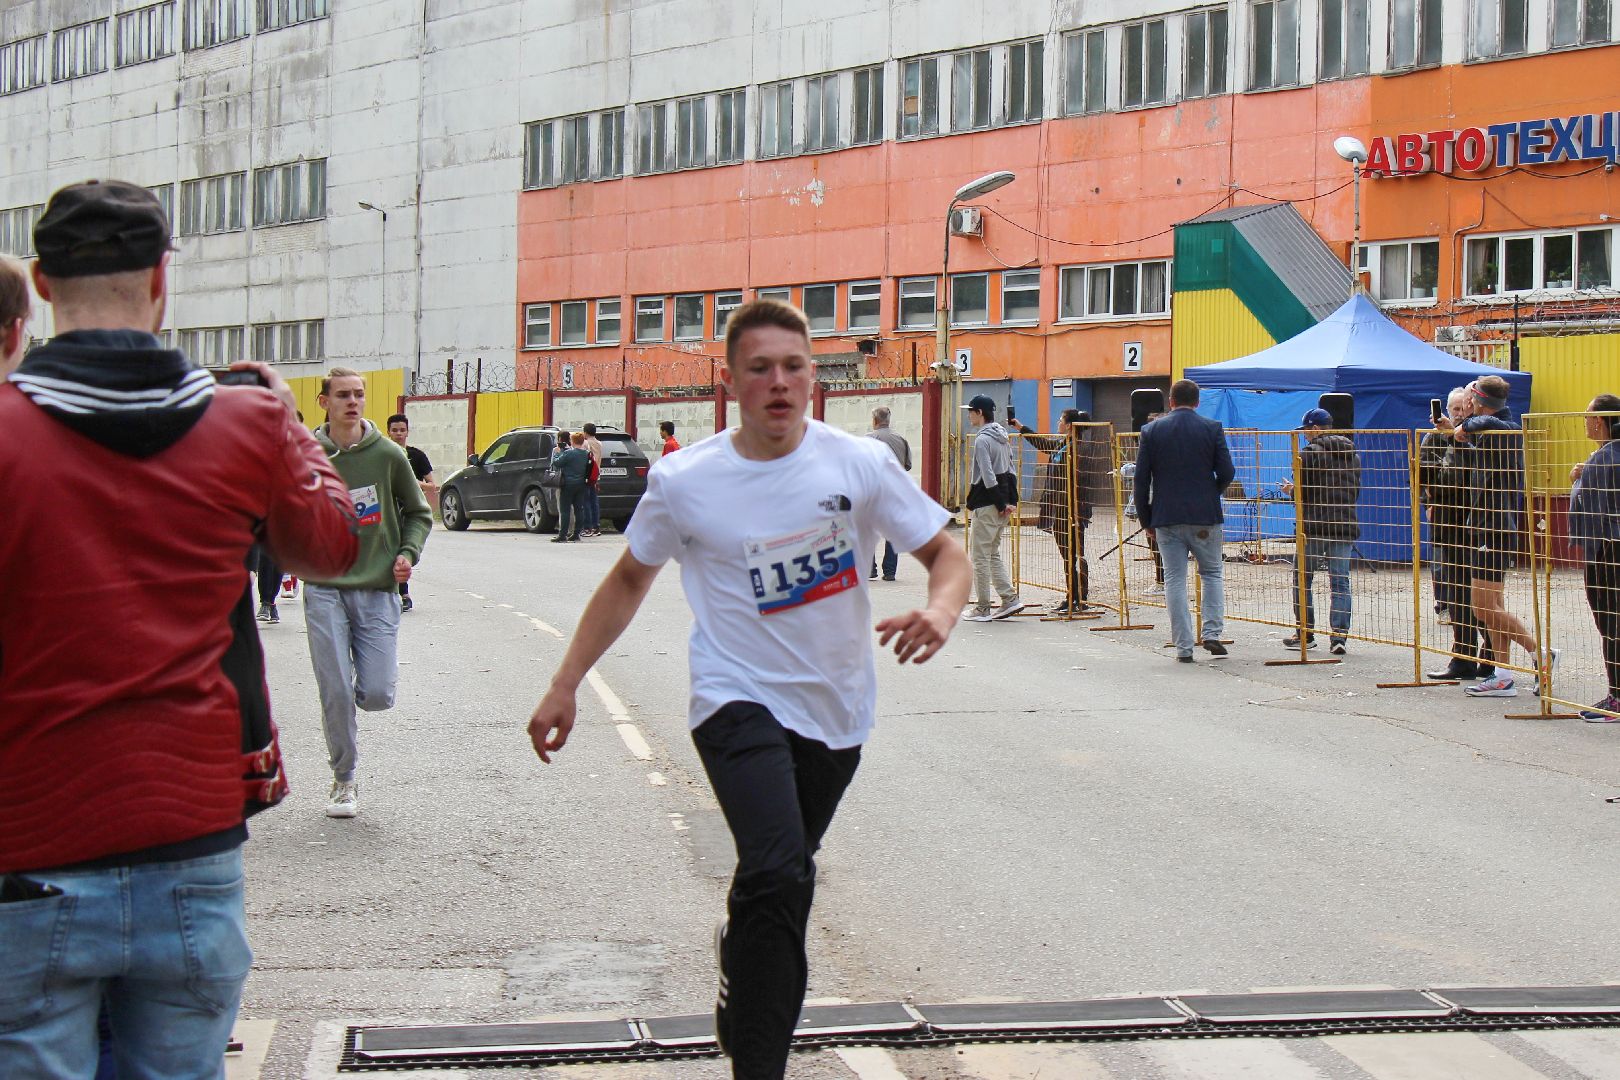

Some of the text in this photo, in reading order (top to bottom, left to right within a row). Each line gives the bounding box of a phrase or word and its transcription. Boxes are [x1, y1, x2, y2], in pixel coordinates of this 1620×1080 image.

[1363, 111, 1620, 179] АВТОТЕХЦ
[959, 353, 968, 373] 3
[1128, 346, 1138, 367] 2
[564, 368, 572, 385] 5
[354, 501, 367, 518] 9
[770, 546, 840, 593] 135
